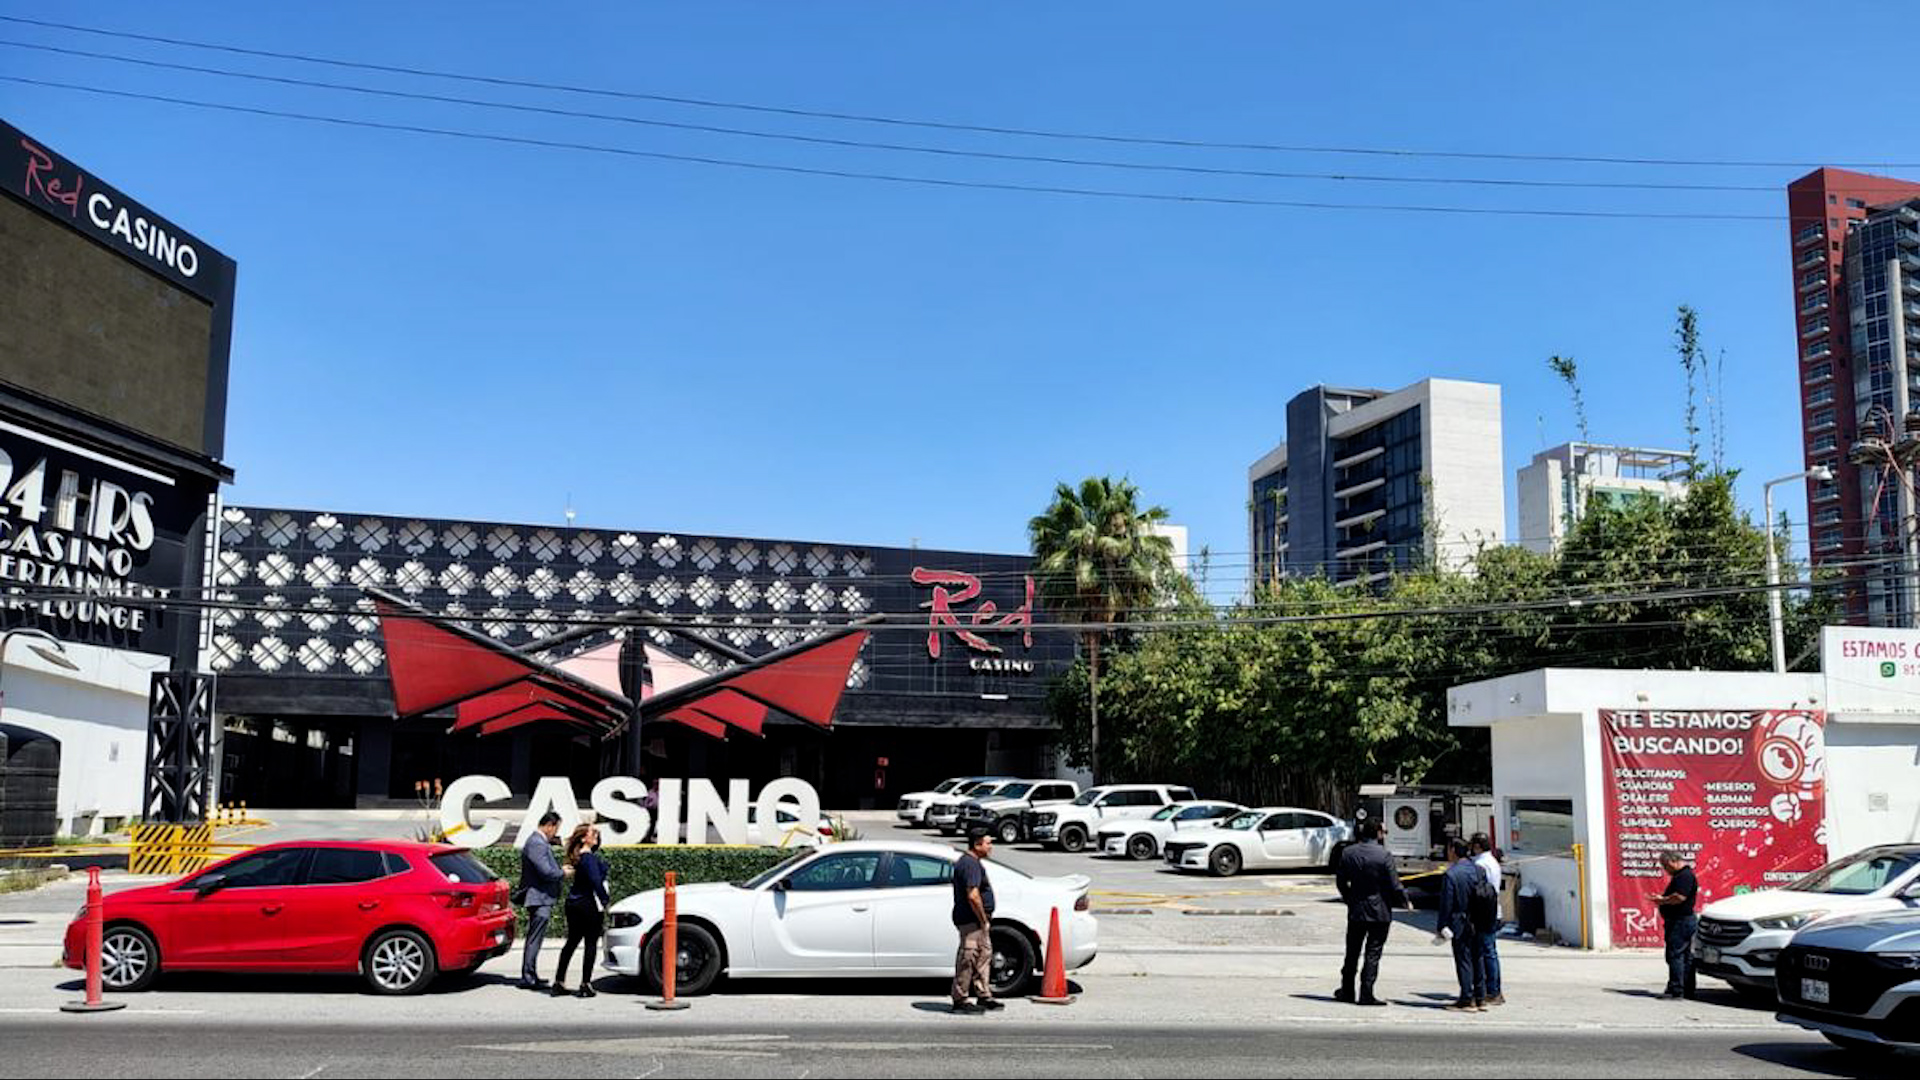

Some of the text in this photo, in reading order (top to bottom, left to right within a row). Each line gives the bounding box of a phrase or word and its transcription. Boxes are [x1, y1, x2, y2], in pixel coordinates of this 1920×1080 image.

[21, 137, 198, 278] Red CASINO
[55, 468, 154, 550] HRS
[911, 566, 1034, 658] Red
[1843, 640, 1906, 659] ESTAMOS
[970, 658, 1034, 672] CASINO
[1649, 711, 1751, 729] ESTAMOS
[1613, 736, 1743, 755] BUSCANDO!
[440, 774, 820, 849] CASINO
[1661, 806, 1702, 816] PUNTOS
[1619, 907, 1658, 934] Red
[1626, 935, 1659, 943] CASINO
